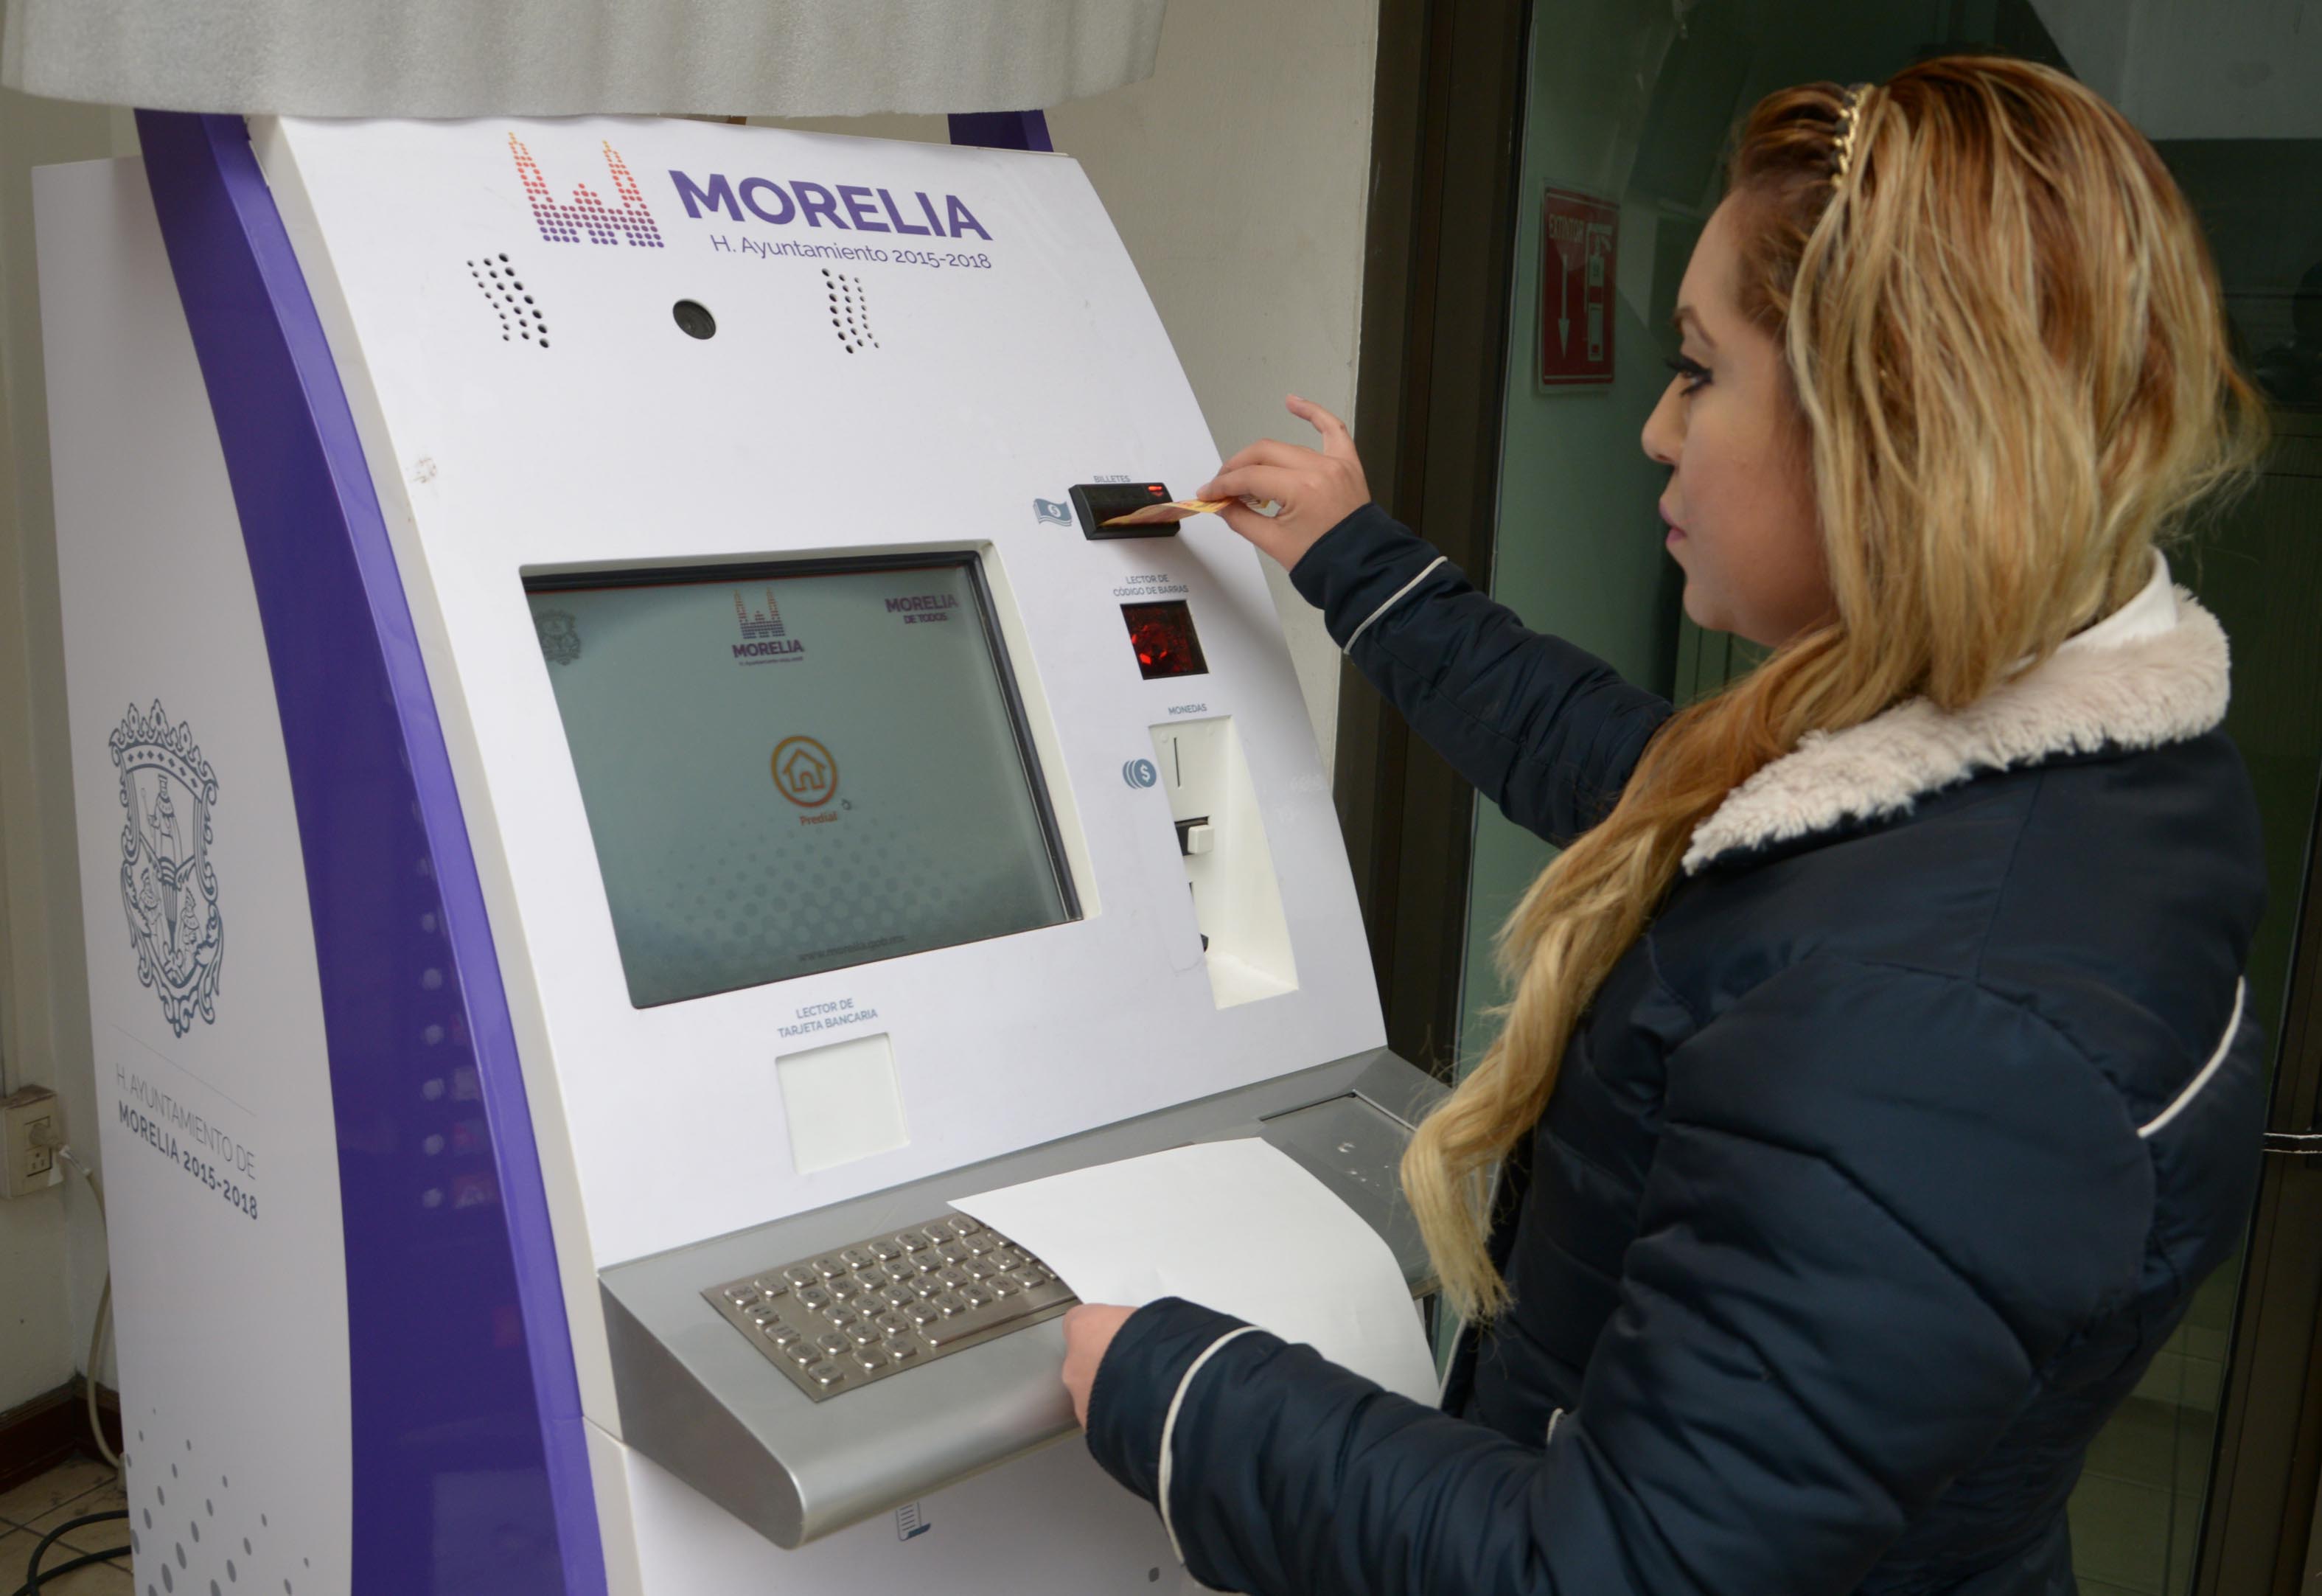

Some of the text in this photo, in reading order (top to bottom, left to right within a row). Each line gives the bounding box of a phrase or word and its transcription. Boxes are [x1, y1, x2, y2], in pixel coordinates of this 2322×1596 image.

[668, 170, 994, 241] MORELIA
[710, 234, 992, 269] H. Ayuntamiento 2015-2018
[1093, 475, 1132, 483] BILLETES
[1126, 574, 1169, 584] LECTOR DE
[1157, 585, 1189, 594] BARRAS
[885, 594, 959, 613] MORELIA
[903, 615, 917, 624] DE
[731, 639, 804, 658] MORELIA
[1168, 703, 1207, 715] MONEDAS
[799, 811, 838, 826] Predial
[796, 998, 854, 1019] LECTOR DE
[777, 1008, 878, 1038] TARJETA BANCARIA
[130, 1073, 233, 1162] AYUNTAMIENTO
[236, 1144, 256, 1180] DE
[119, 1100, 257, 1220] MORELIA 2015-2018
